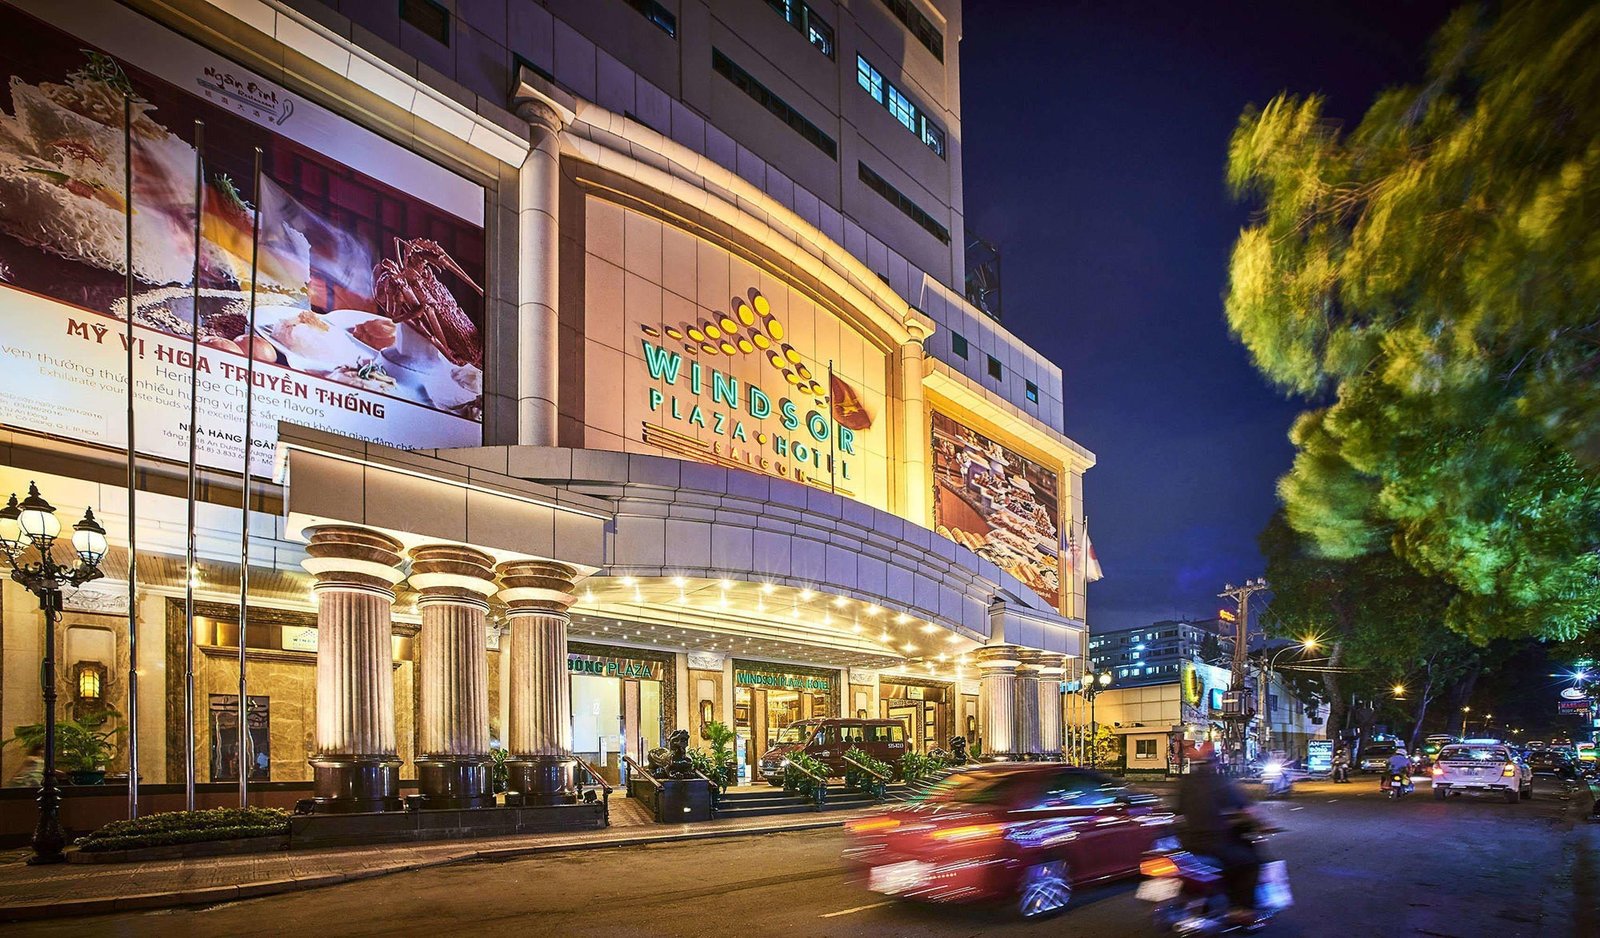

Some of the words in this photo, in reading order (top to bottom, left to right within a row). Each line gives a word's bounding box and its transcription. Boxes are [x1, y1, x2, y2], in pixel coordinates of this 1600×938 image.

[66, 317, 108, 344] MỸ
[154, 344, 211, 374] HOA
[219, 361, 308, 399] TRUYỀN
[314, 387, 385, 419] THỐNG
[99, 383, 124, 395] your
[155, 365, 221, 392] Heritage
[283, 397, 325, 418] flavors
[641, 339, 855, 455] WINDSOR
[649, 387, 747, 442] PLAZA
[208, 429, 242, 443] HÀNG
[713, 441, 806, 482] SAIGON
[608, 661, 652, 677] PLAZA
[737, 673, 777, 686] WINDSOR
[806, 678, 829, 690] HOTEL
